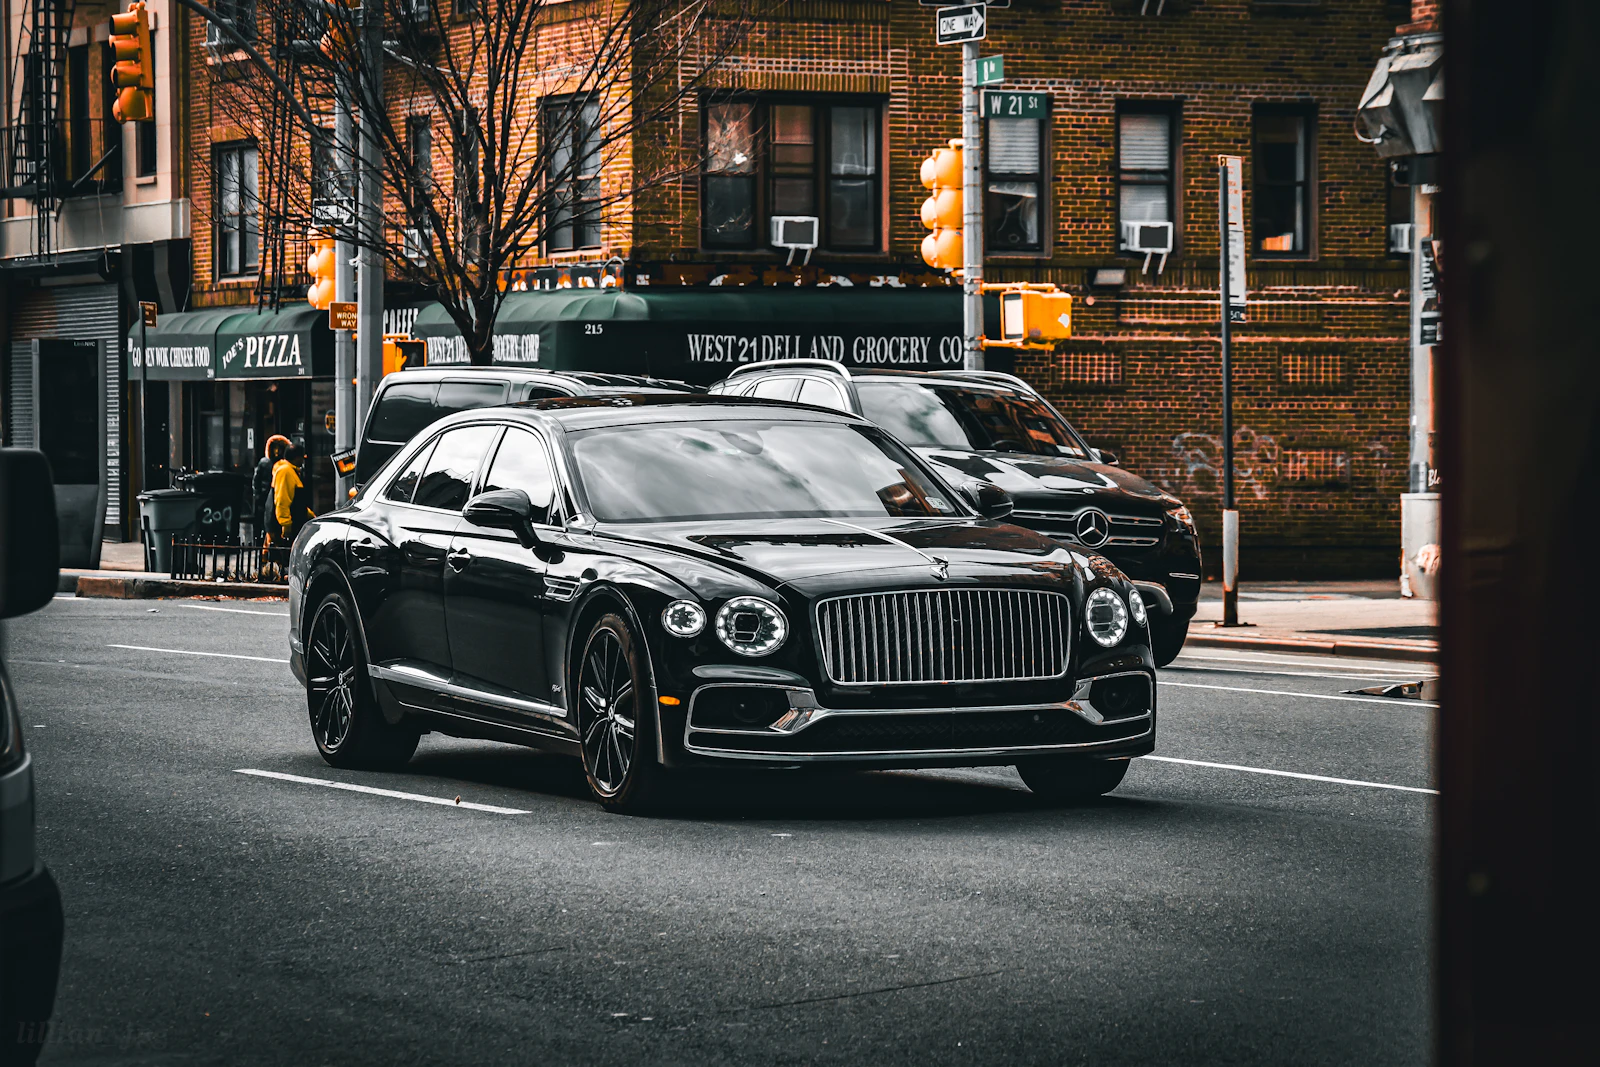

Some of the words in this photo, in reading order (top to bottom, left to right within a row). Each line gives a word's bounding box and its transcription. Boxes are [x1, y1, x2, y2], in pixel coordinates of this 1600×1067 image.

[942, 19, 956, 32] ONE
[963, 15, 979, 29] WAY
[991, 96, 1002, 114] W
[1008, 96, 1023, 115] 21
[1028, 96, 1038, 109] St
[336, 312, 358, 320] WRON
[585, 324, 603, 335] 215
[132, 346, 155, 367] GODEN
[155, 346, 170, 367] WOK
[169, 346, 194, 367] CHINESE
[194, 346, 210, 367] FOOD
[222, 337, 244, 370] JOE'S
[244, 333, 302, 368] PIZZA
[427, 336, 447, 362] WEST
[455, 336, 471, 362] DEL
[492, 334, 519, 361] ROCERY
[521, 334, 540, 361] CORP
[687, 334, 736, 363] WEST
[738, 337, 758, 362] 21
[761, 335, 801, 362] DELI
[809, 335, 845, 363] AND
[852, 336, 931, 364] GROCERY
[939, 335, 964, 364] CO
[202, 506, 232, 532] 209
